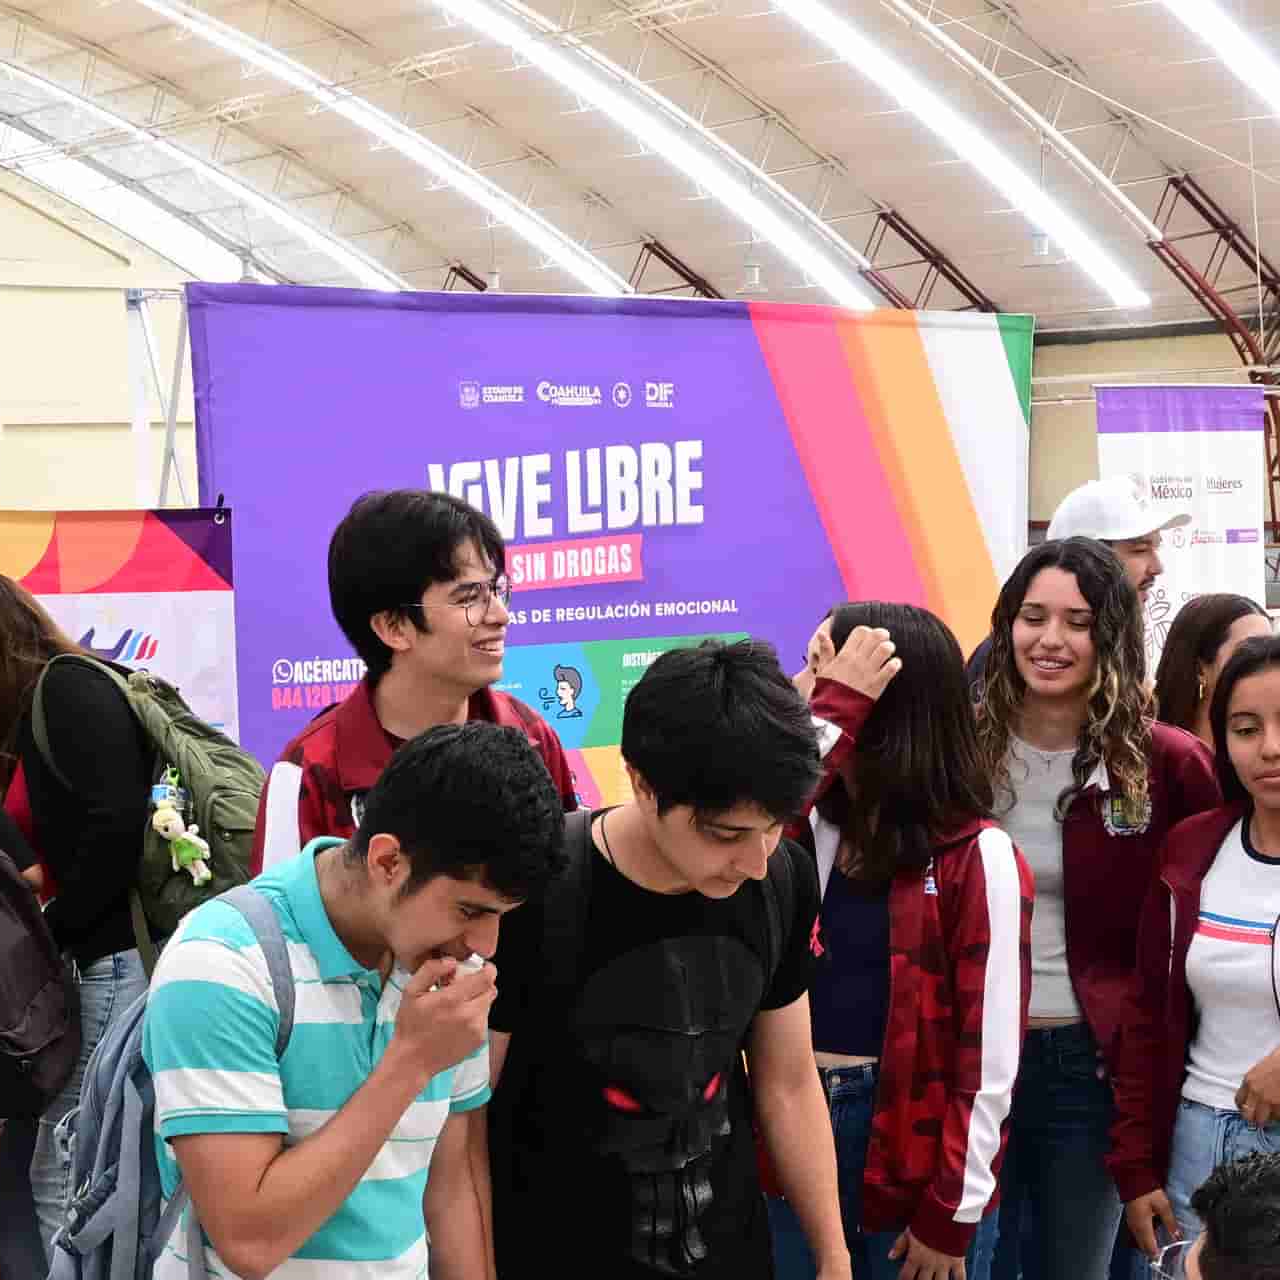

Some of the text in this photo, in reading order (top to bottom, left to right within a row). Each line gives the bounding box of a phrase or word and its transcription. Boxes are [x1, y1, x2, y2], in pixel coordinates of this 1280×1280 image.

[645, 383, 674, 400] DIF
[565, 440, 704, 533] LIBRE
[1150, 484, 1193, 500] México
[511, 543, 633, 584] SIN DROGAS
[531, 606, 552, 623] DE
[556, 600, 651, 622] REGULACIÓN
[655, 600, 739, 617] EMOCIONAL
